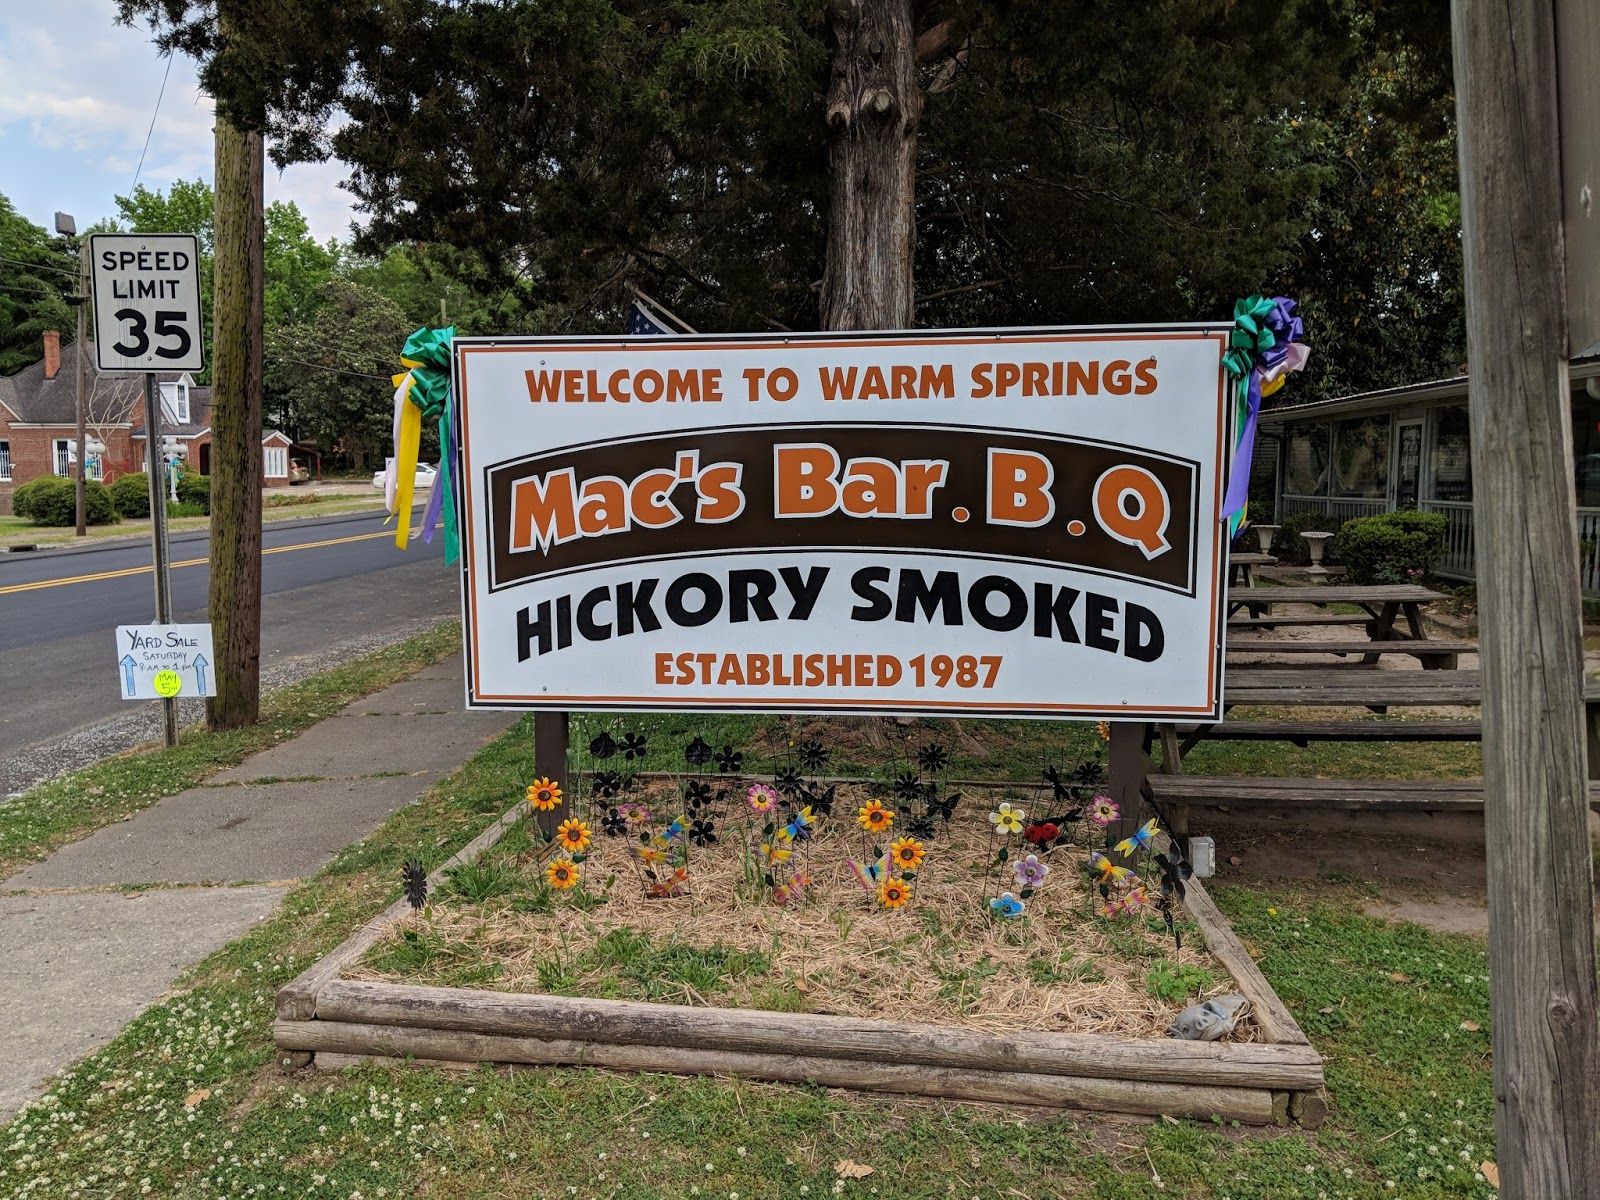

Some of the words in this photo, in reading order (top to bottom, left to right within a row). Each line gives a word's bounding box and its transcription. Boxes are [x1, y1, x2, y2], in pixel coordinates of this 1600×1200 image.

[102, 251, 189, 271] SPEED
[112, 279, 180, 299] LIMIT
[112, 308, 191, 360] 35
[524, 368, 723, 403] WELCOME
[742, 367, 799, 402] TO
[818, 364, 955, 401] WARM
[970, 359, 1159, 399] SPRINGS
[508, 448, 746, 558] Mac's
[516, 566, 831, 663] HICKORY
[850, 566, 1165, 663] SMOKED
[126, 629, 162, 650] YARD
[165, 631, 199, 648] SALE
[142, 651, 188, 664] SATURDAY
[655, 652, 903, 687] ESTABLISHED
[908, 653, 1003, 688] 1987
[159, 672, 177, 684] MAY
